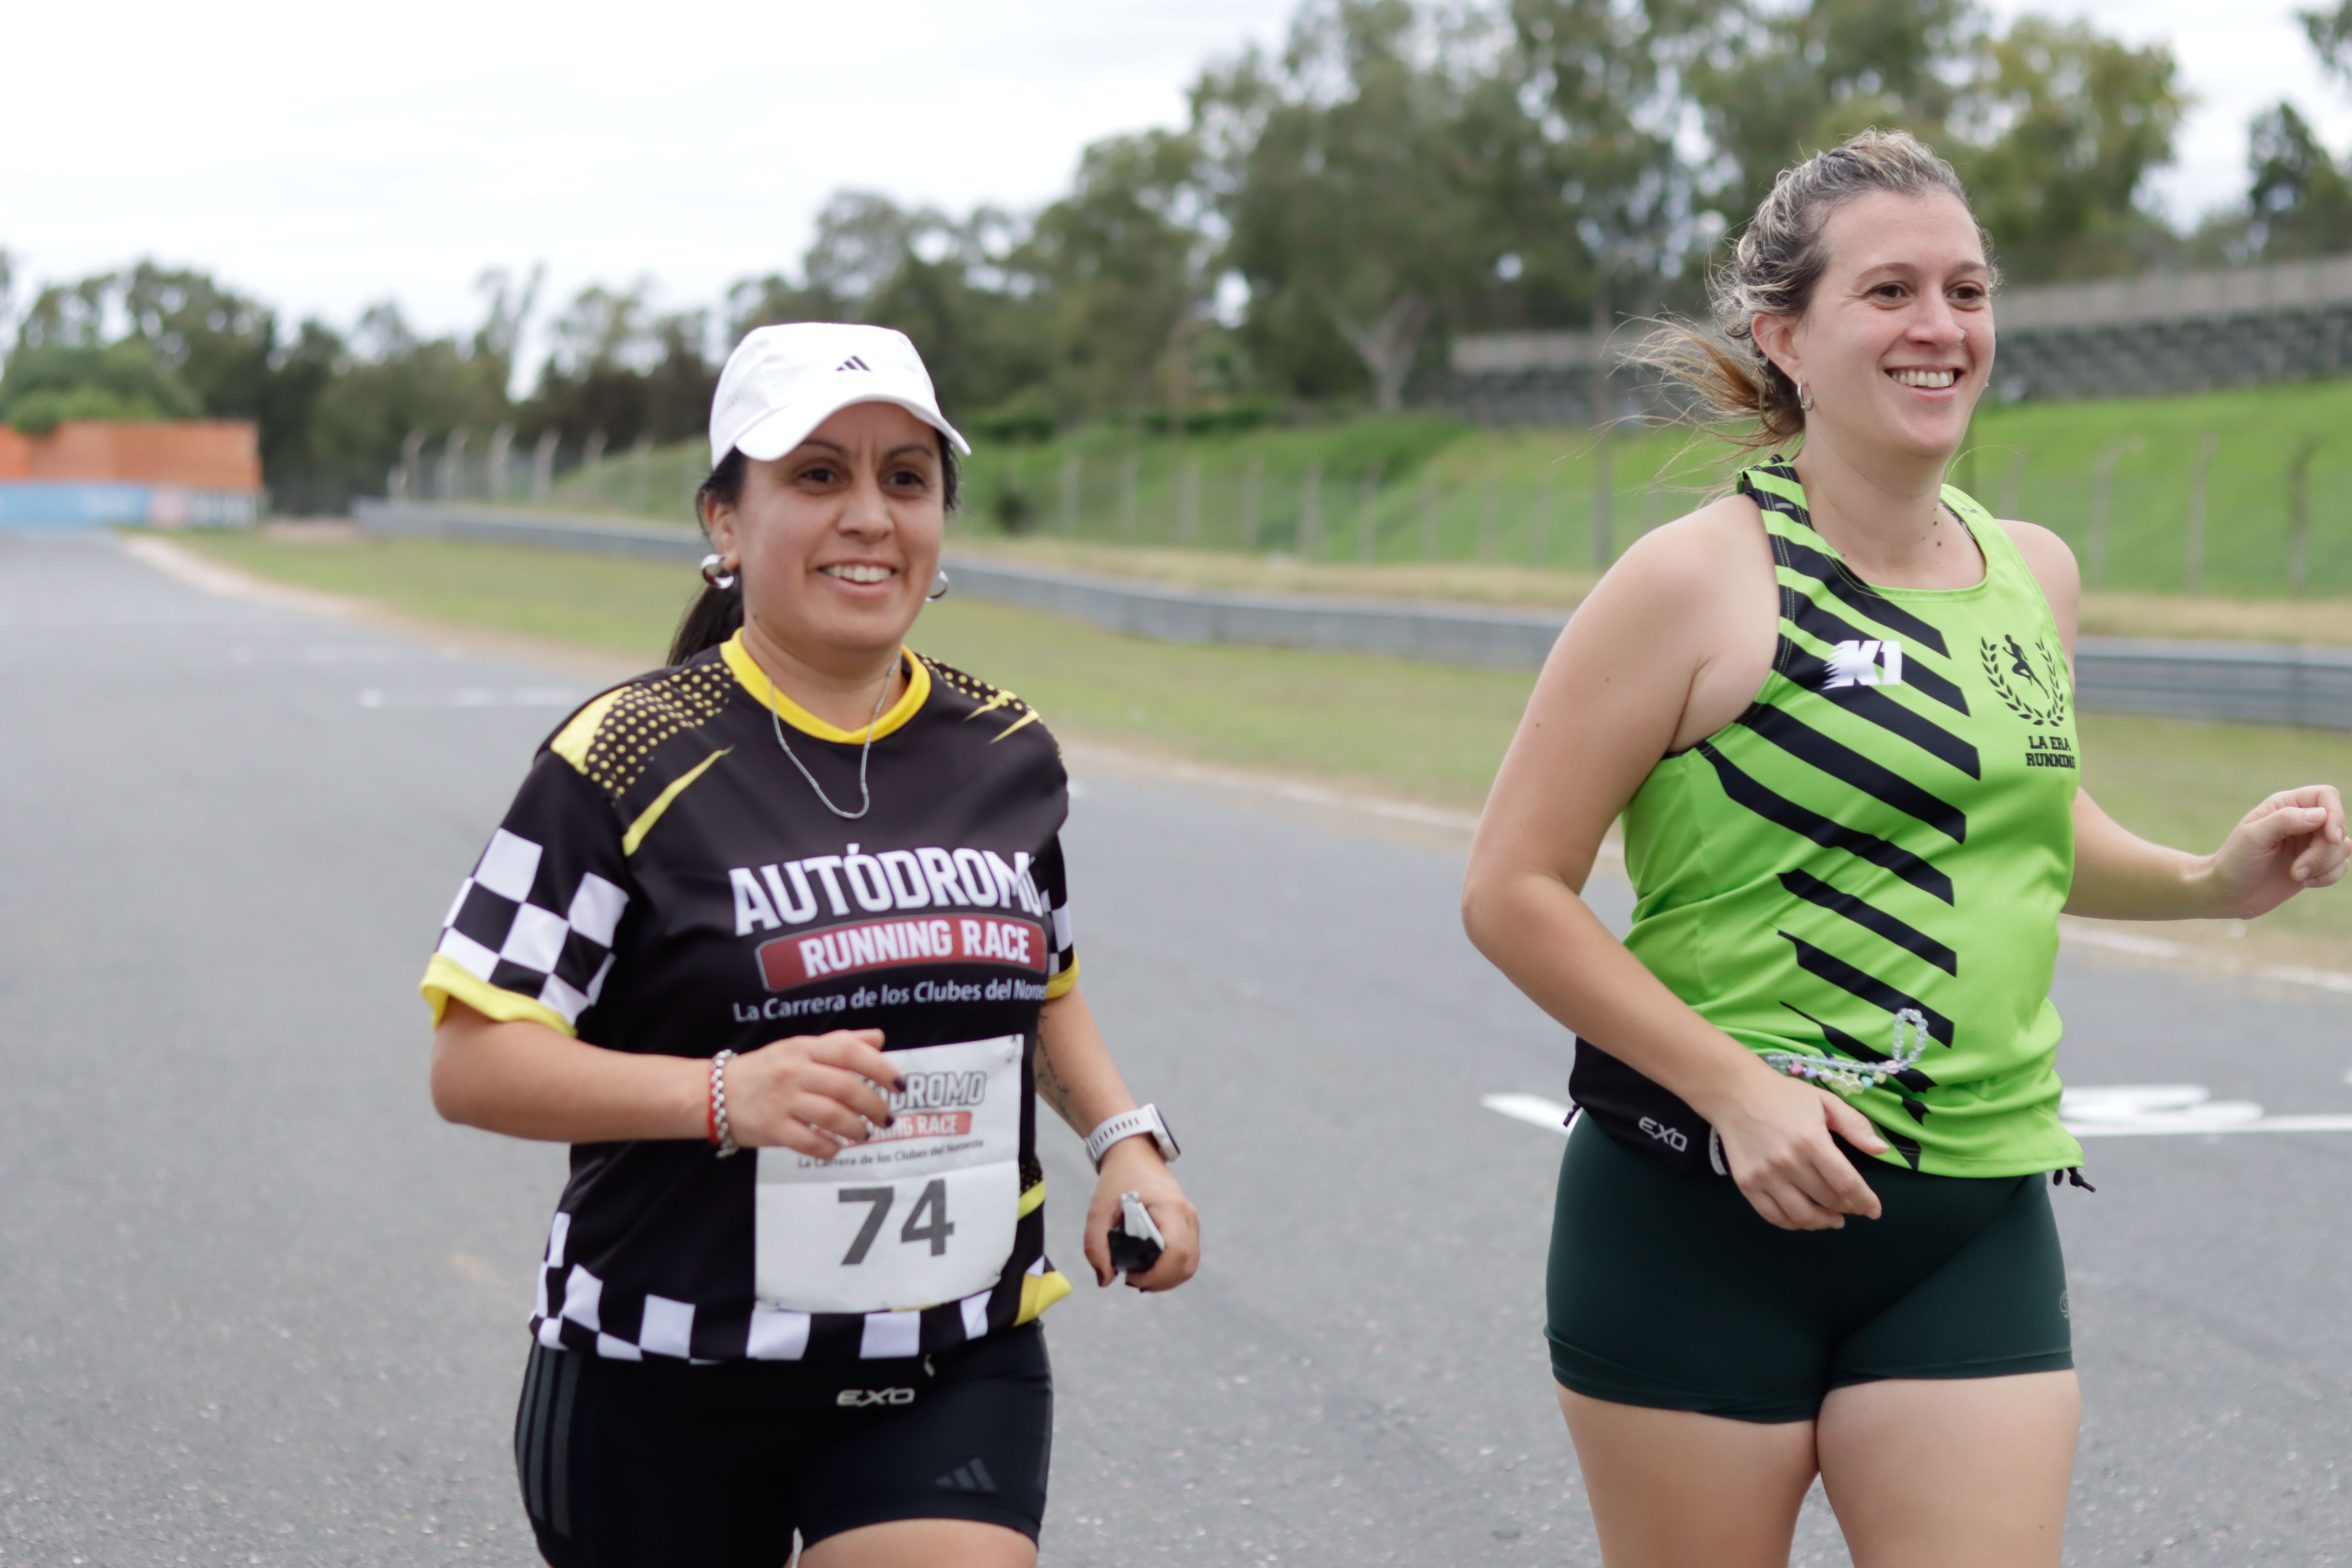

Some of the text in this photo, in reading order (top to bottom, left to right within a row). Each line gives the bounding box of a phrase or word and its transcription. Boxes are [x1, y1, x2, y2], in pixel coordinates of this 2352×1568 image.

[1821, 640, 1902, 690] K1
[2025, 753, 2076, 769] RUNNING
[2028, 736, 2072, 751] LA ERA
[798, 919, 1030, 978] RUNNING RACE
[733, 1002, 759, 1022] La
[763, 998, 846, 1020] Carrera
[850, 986, 877, 1009] de
[881, 984, 910, 1005] los
[914, 980, 981, 1003] Clubes
[985, 978, 1012, 1000] del
[917, 1115, 957, 1135] RACE
[1639, 1116, 1688, 1152] EXO
[838, 1178, 955, 1266] 74
[836, 1387, 915, 1407] EXO
